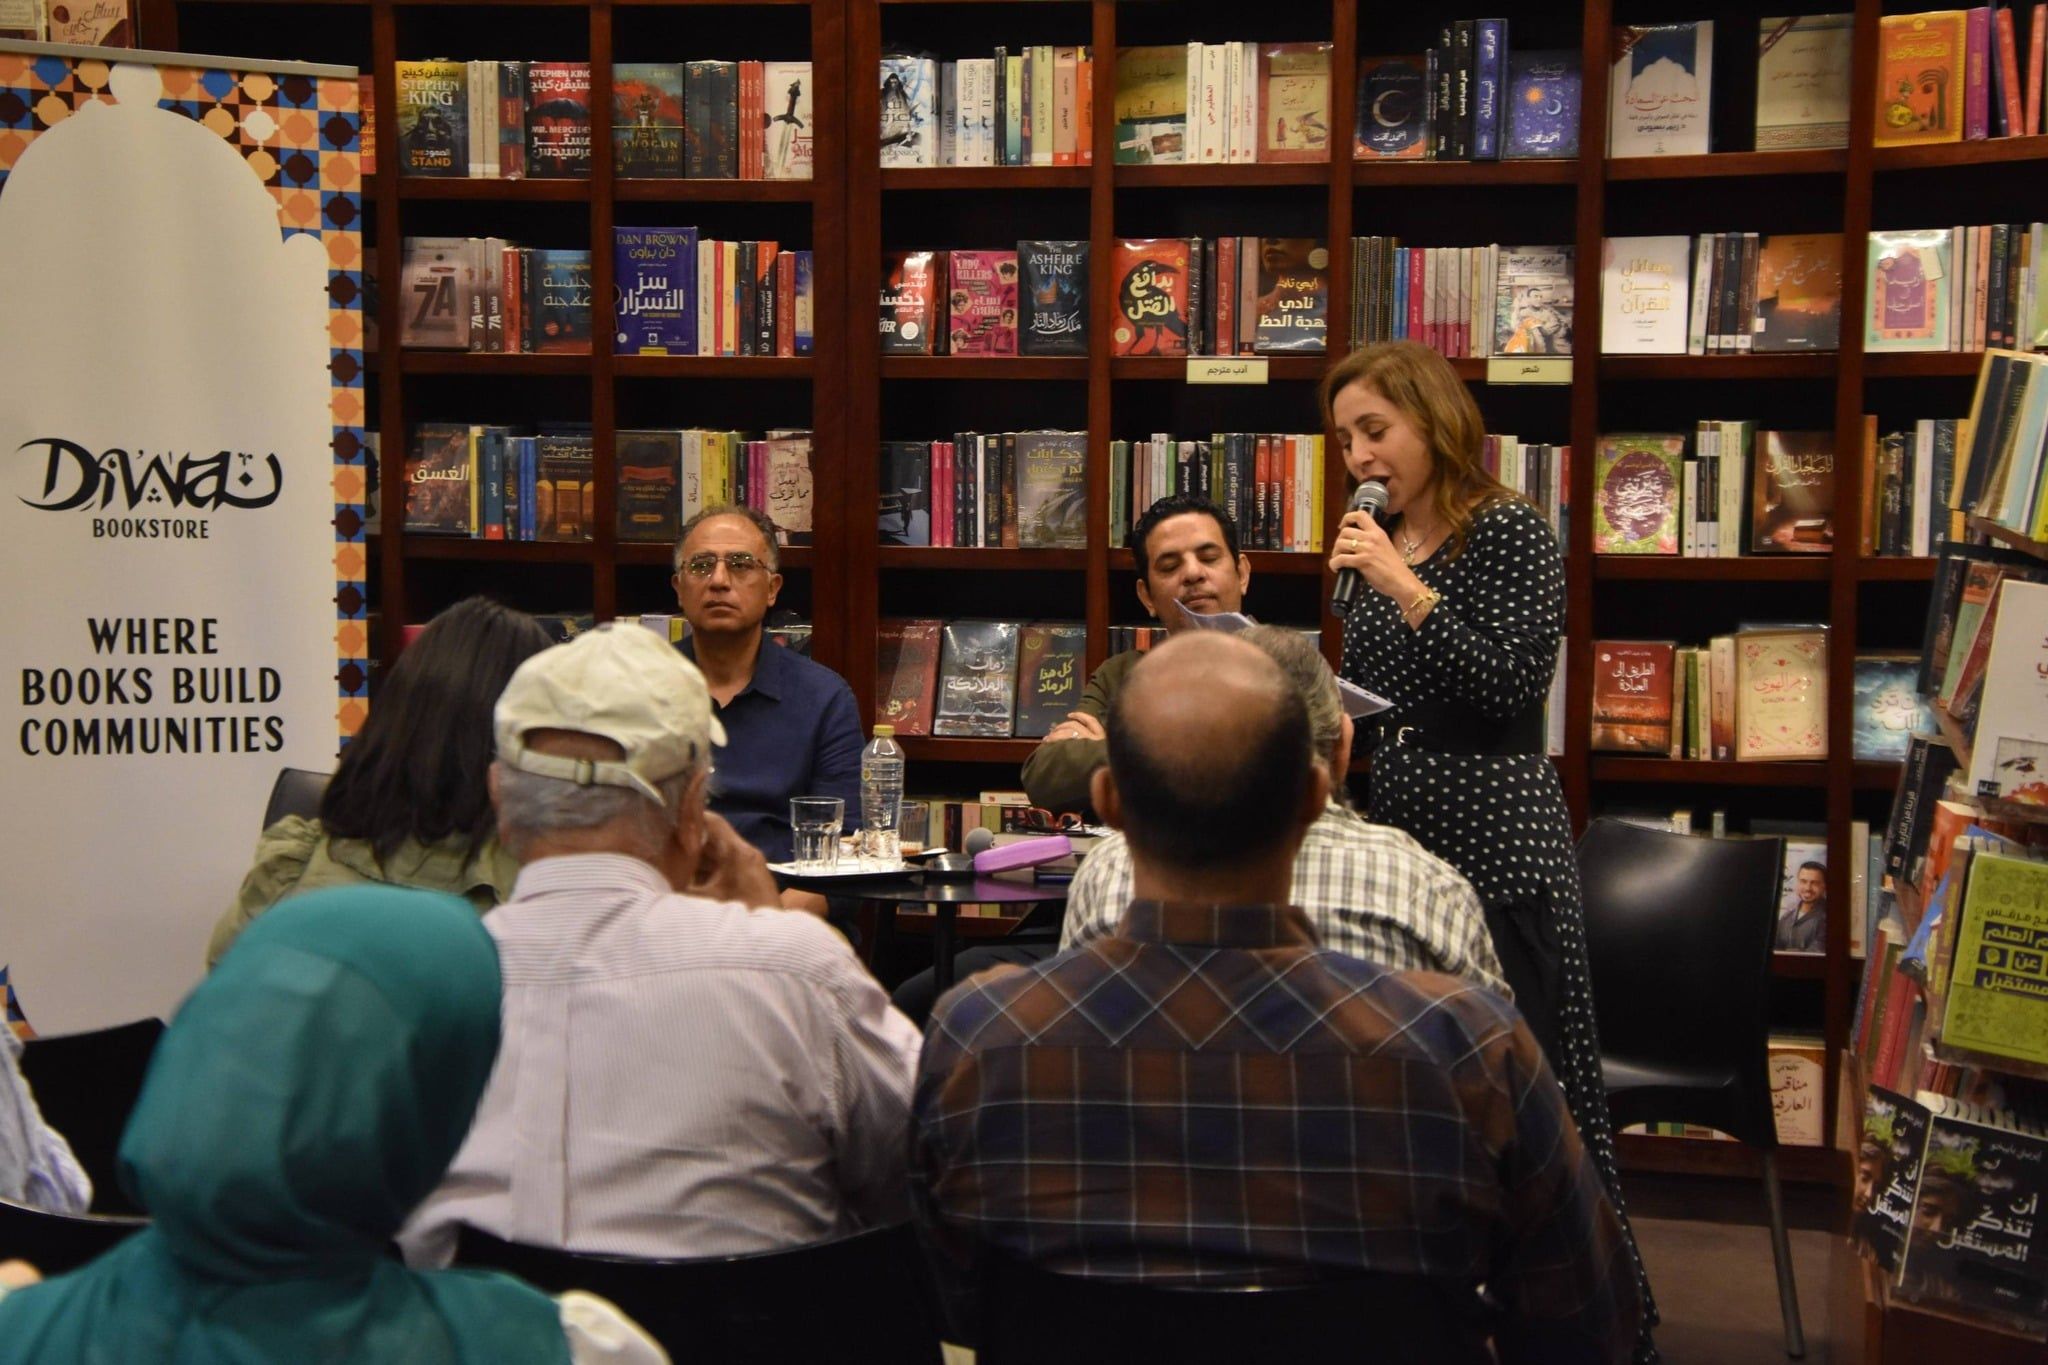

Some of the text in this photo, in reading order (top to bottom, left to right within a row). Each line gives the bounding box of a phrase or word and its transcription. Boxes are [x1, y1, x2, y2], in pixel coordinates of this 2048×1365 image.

[529, 69, 568, 78] STEPHEN
[401, 80, 460, 91] STEPHEN
[408, 90, 453, 106] KING
[622, 139, 679, 149] SHOGUN
[411, 156, 451, 167] STAND
[616, 235, 689, 247] DAN BROWN
[628, 245, 676, 260] دان براون
[1048, 246, 1062, 254] THE
[955, 258, 980, 270] LADY
[1028, 253, 1083, 265] ASHFIRE
[956, 269, 993, 281] KILLERS
[1039, 264, 1073, 275] KING
[543, 274, 592, 291] جلسة
[1620, 277, 1671, 293] من
[543, 293, 592, 309] علاجية
[619, 287, 685, 316] الأسرار
[1128, 295, 1176, 321] القتل
[1278, 296, 1314, 311] نادي
[1620, 293, 1671, 314] القرآن
[1259, 313, 1293, 327] الحظ
[1206, 364, 1248, 377] أدب مترجم
[1521, 364, 1540, 375] شعر
[1026, 448, 1083, 461] حكايات
[410, 463, 470, 484] الغسق
[93, 518, 209, 538] BOOKSTORE
[87, 617, 218, 654] WHERE
[1038, 657, 1075, 681] كل هذا
[22, 666, 282, 705] BOOKS BUILD
[1037, 677, 1073, 695] الرماد
[20, 715, 284, 756] COMMUNITIES
[1984, 925, 2036, 945] العلم
[2015, 953, 2040, 970] عن
[1772, 1093, 1812, 1117] العارفي
[1904, 1159, 1919, 1181] أن
[2009, 1192, 2039, 1216] أن
[1936, 1226, 2029, 1263] المستقبل
